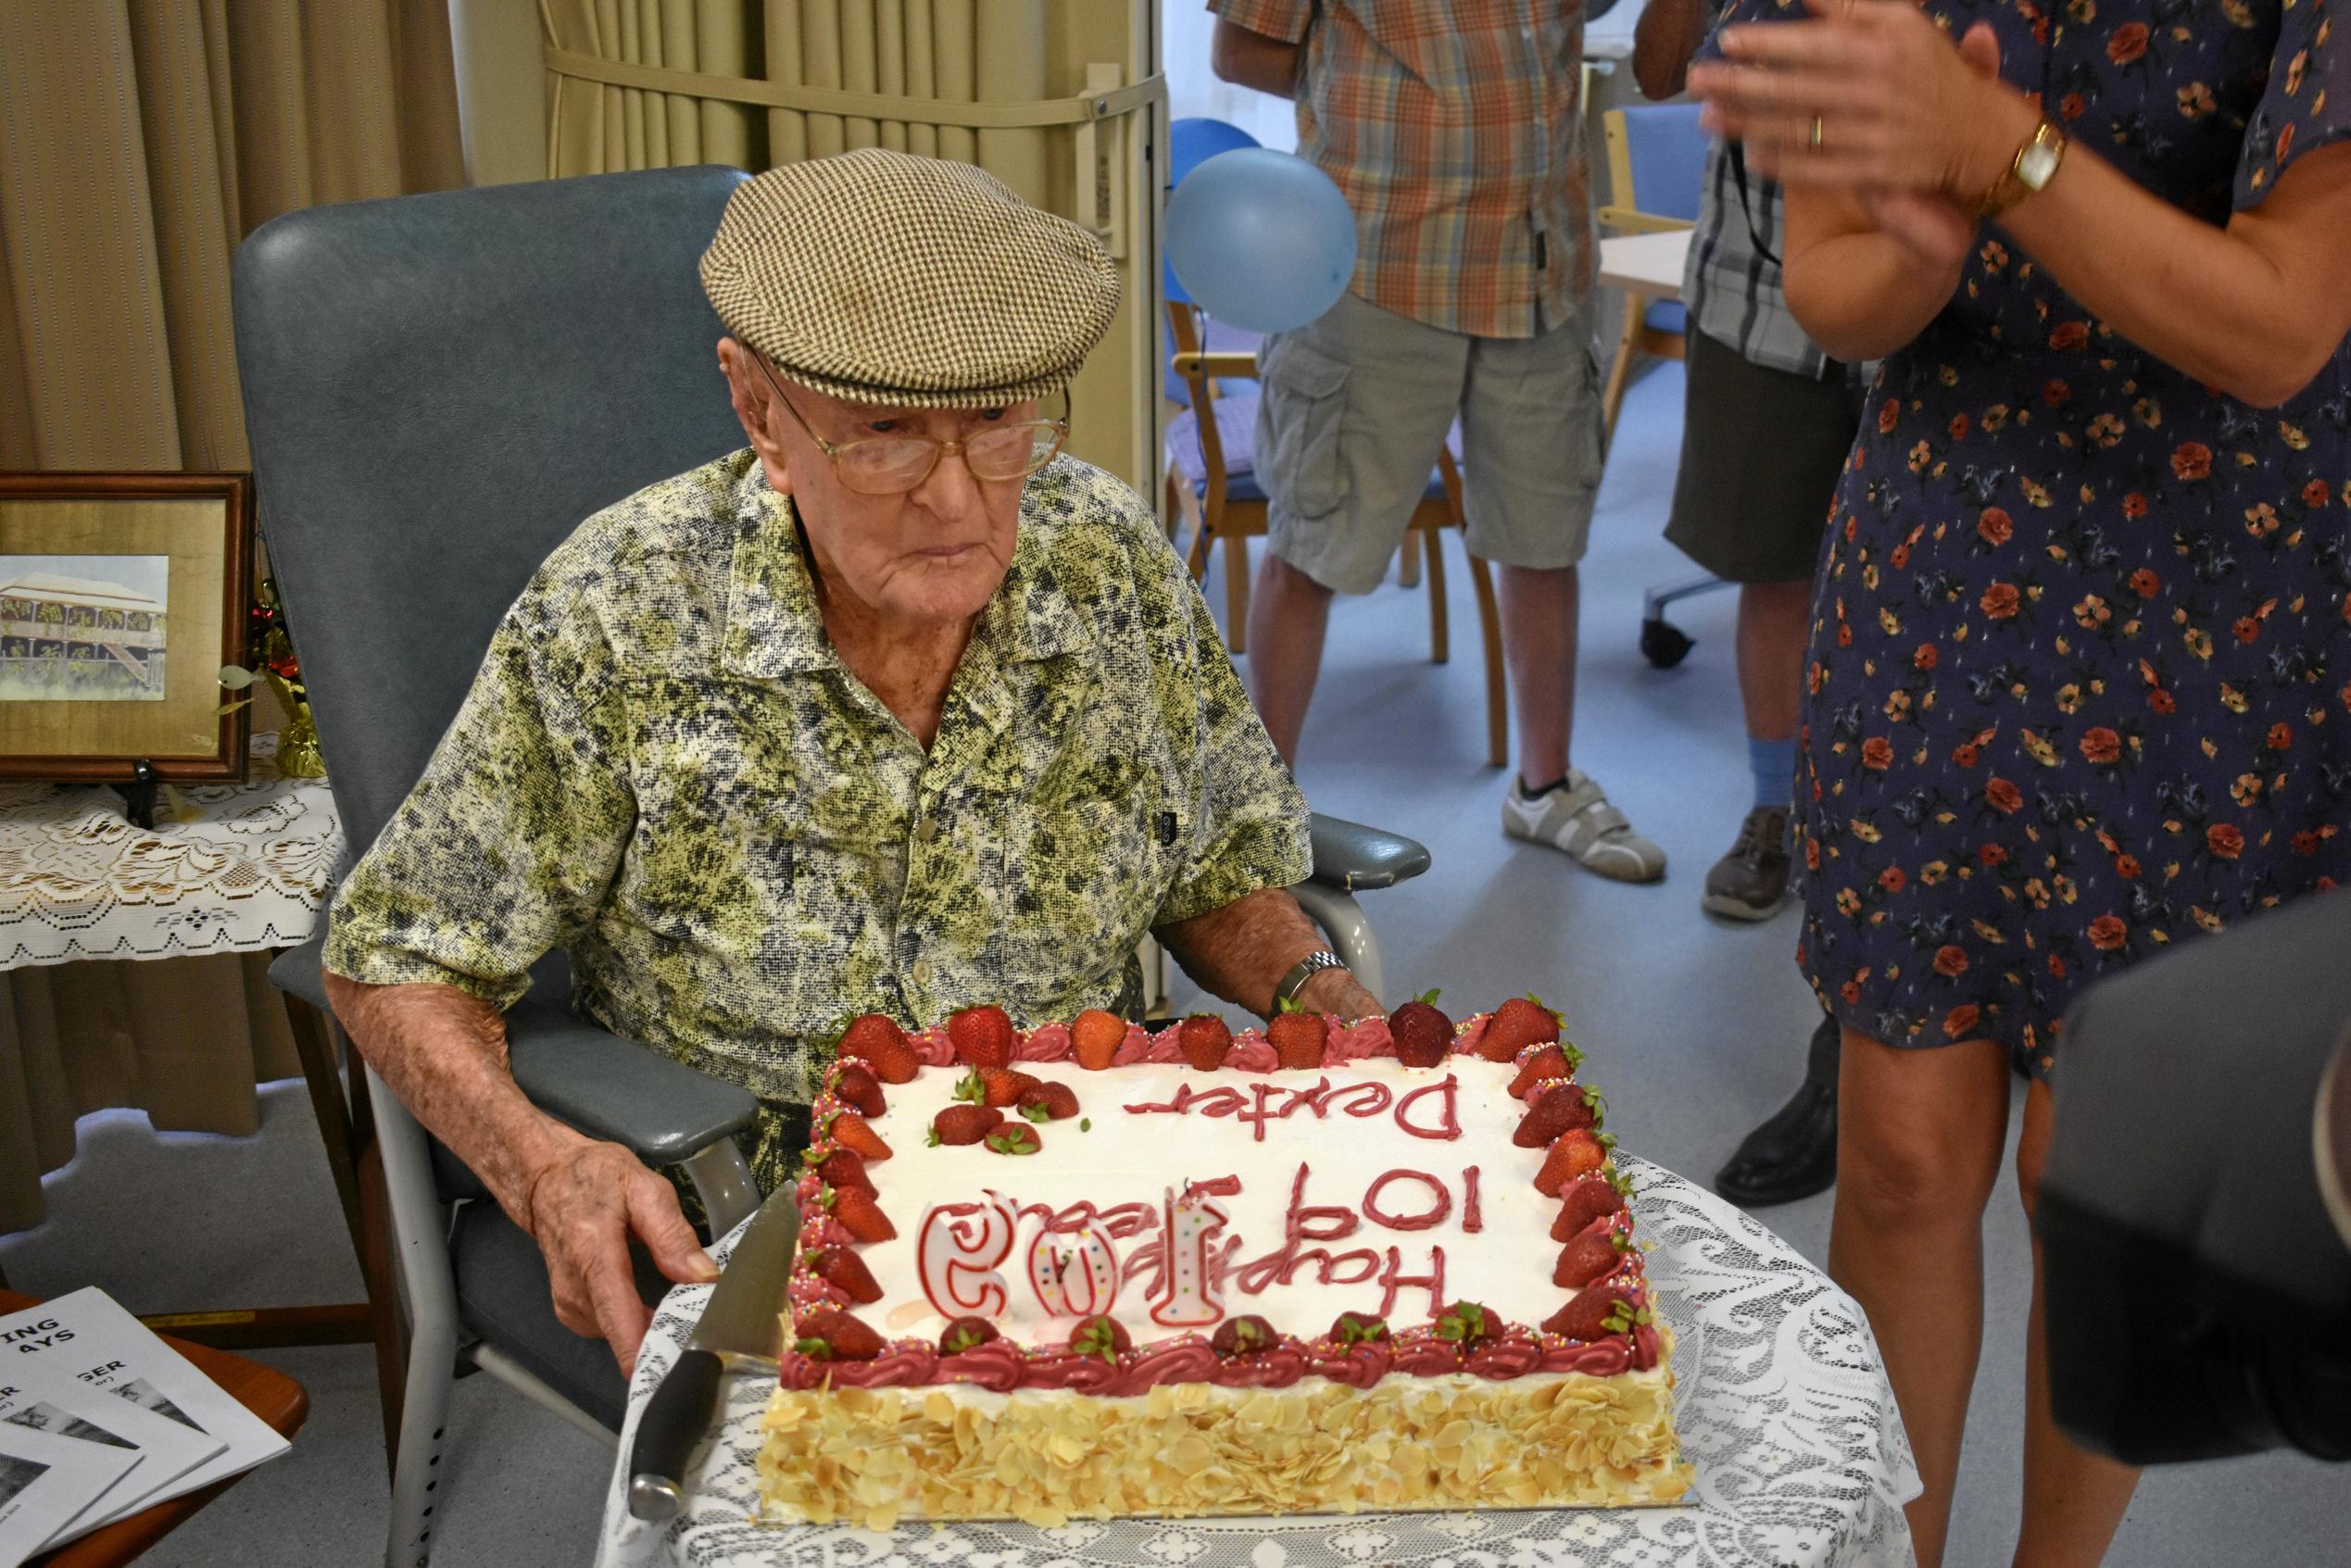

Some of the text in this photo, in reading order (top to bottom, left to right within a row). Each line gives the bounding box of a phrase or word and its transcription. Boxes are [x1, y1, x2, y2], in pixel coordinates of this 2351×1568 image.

[1123, 1073, 1462, 1141] Dexter
[1286, 1161, 1482, 1241] 109
[0, 1319, 59, 1344] ING
[19, 1330, 75, 1353] AYS
